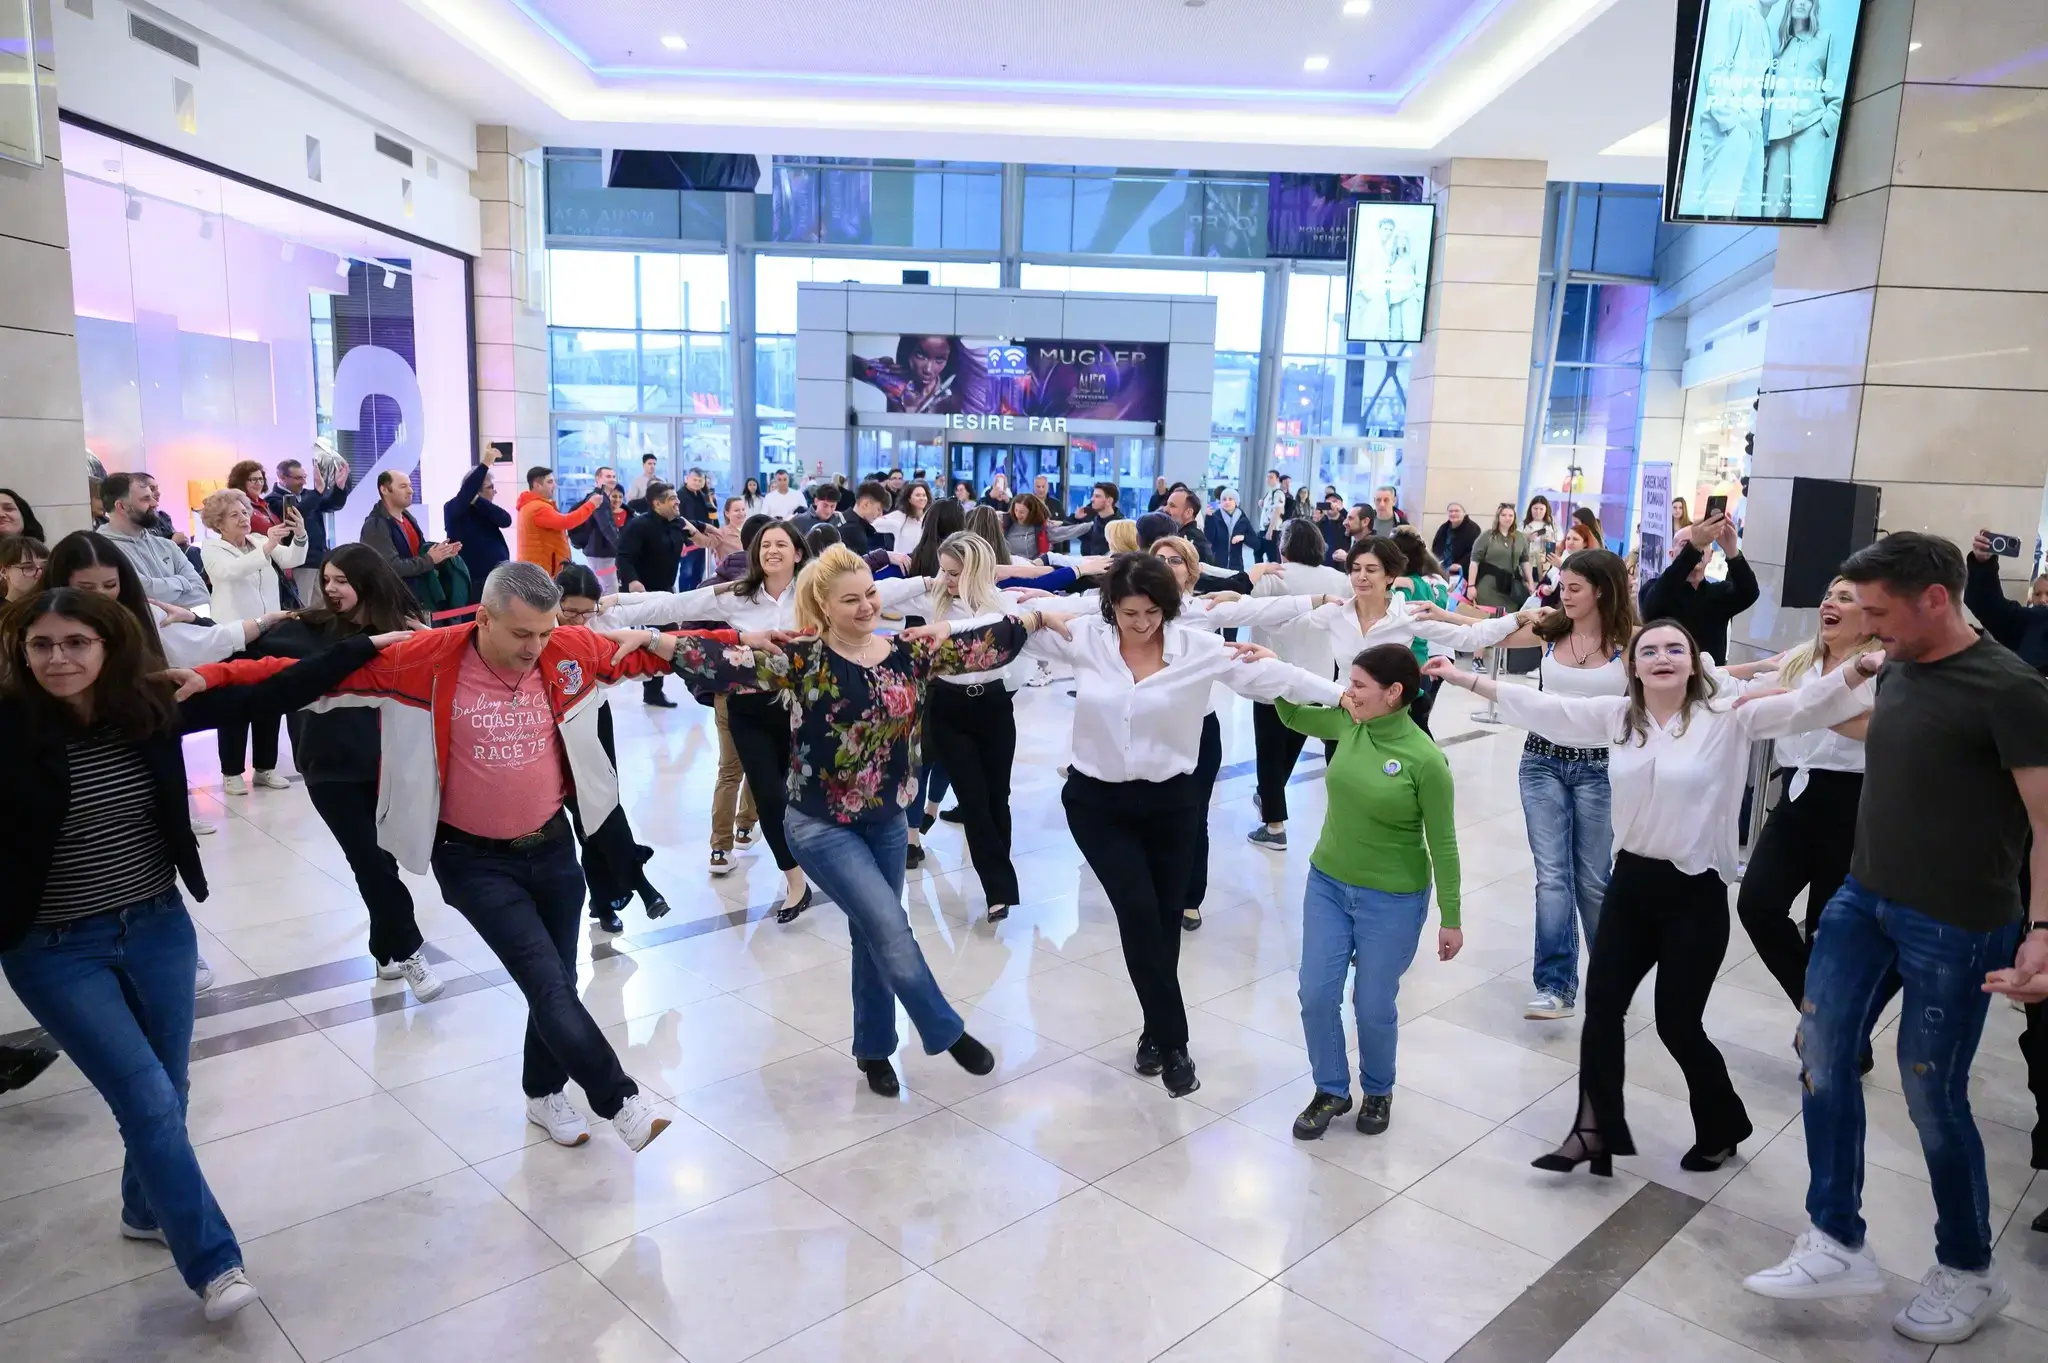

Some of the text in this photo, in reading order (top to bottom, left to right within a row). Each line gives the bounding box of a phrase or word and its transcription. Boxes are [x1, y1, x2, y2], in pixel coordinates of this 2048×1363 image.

[1029, 416, 1067, 433] FAR
[451, 692, 501, 720] Sailing
[471, 711, 546, 728] COASTAL
[474, 738, 546, 759] RACE 75
